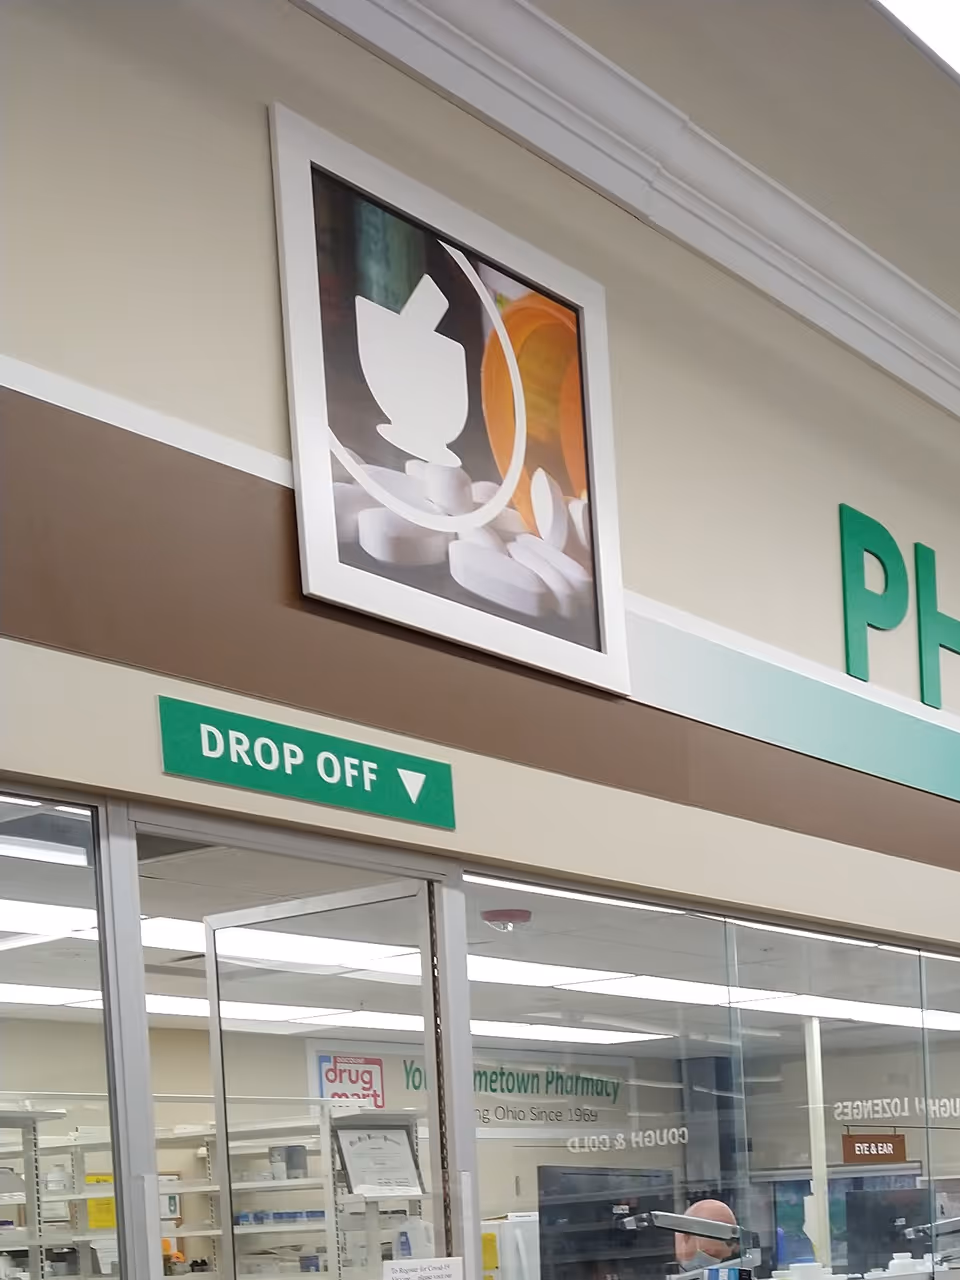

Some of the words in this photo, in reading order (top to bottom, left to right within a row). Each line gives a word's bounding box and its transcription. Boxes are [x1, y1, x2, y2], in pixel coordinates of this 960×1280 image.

[200, 722, 304, 775] DROP
[316, 750, 378, 792] OFF
[325, 1066, 373, 1091] drug
[473, 1066, 540, 1095] metown
[545, 1069, 620, 1104] Pharmacy
[494, 1105, 526, 1121] Ohio
[529, 1106, 562, 1122] Since
[568, 1107, 598, 1123] 1969
[855, 1143, 869, 1155] EYE
[877, 1143, 894, 1155] EAR
